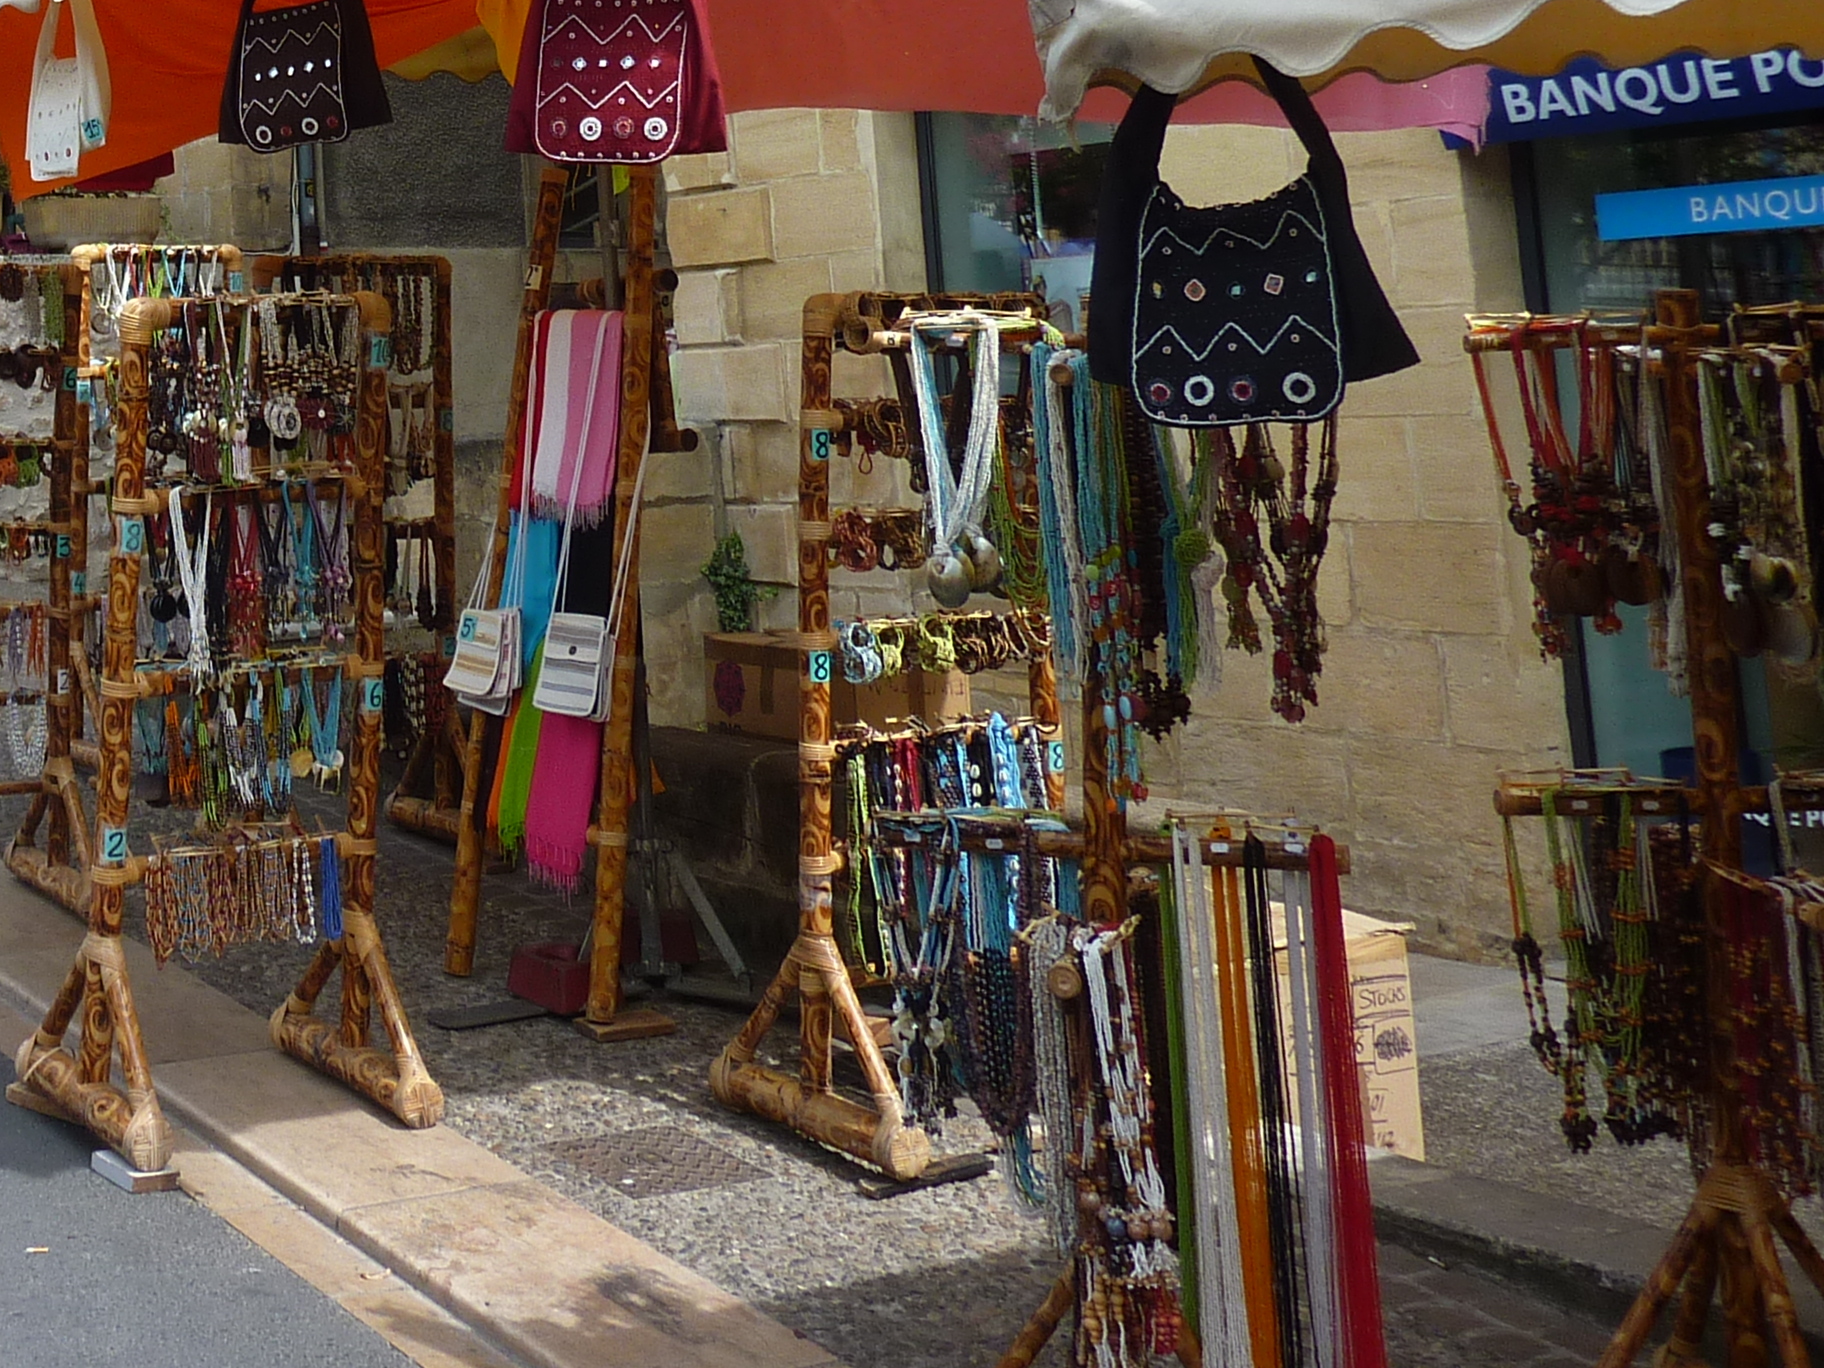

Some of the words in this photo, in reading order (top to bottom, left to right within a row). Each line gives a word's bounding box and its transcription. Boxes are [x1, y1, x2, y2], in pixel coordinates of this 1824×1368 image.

[1500, 59, 1740, 123] BANQUE
[1689, 185, 1824, 224] BANQU
[65, 368, 76, 390] 6
[815, 432, 829, 459] 8
[58, 539, 71, 560] 3
[127, 523, 142, 552] 8
[814, 653, 828, 680] 8
[370, 682, 382, 708] 6
[1053, 743, 1063, 770] 8
[107, 831, 124, 858] 2
